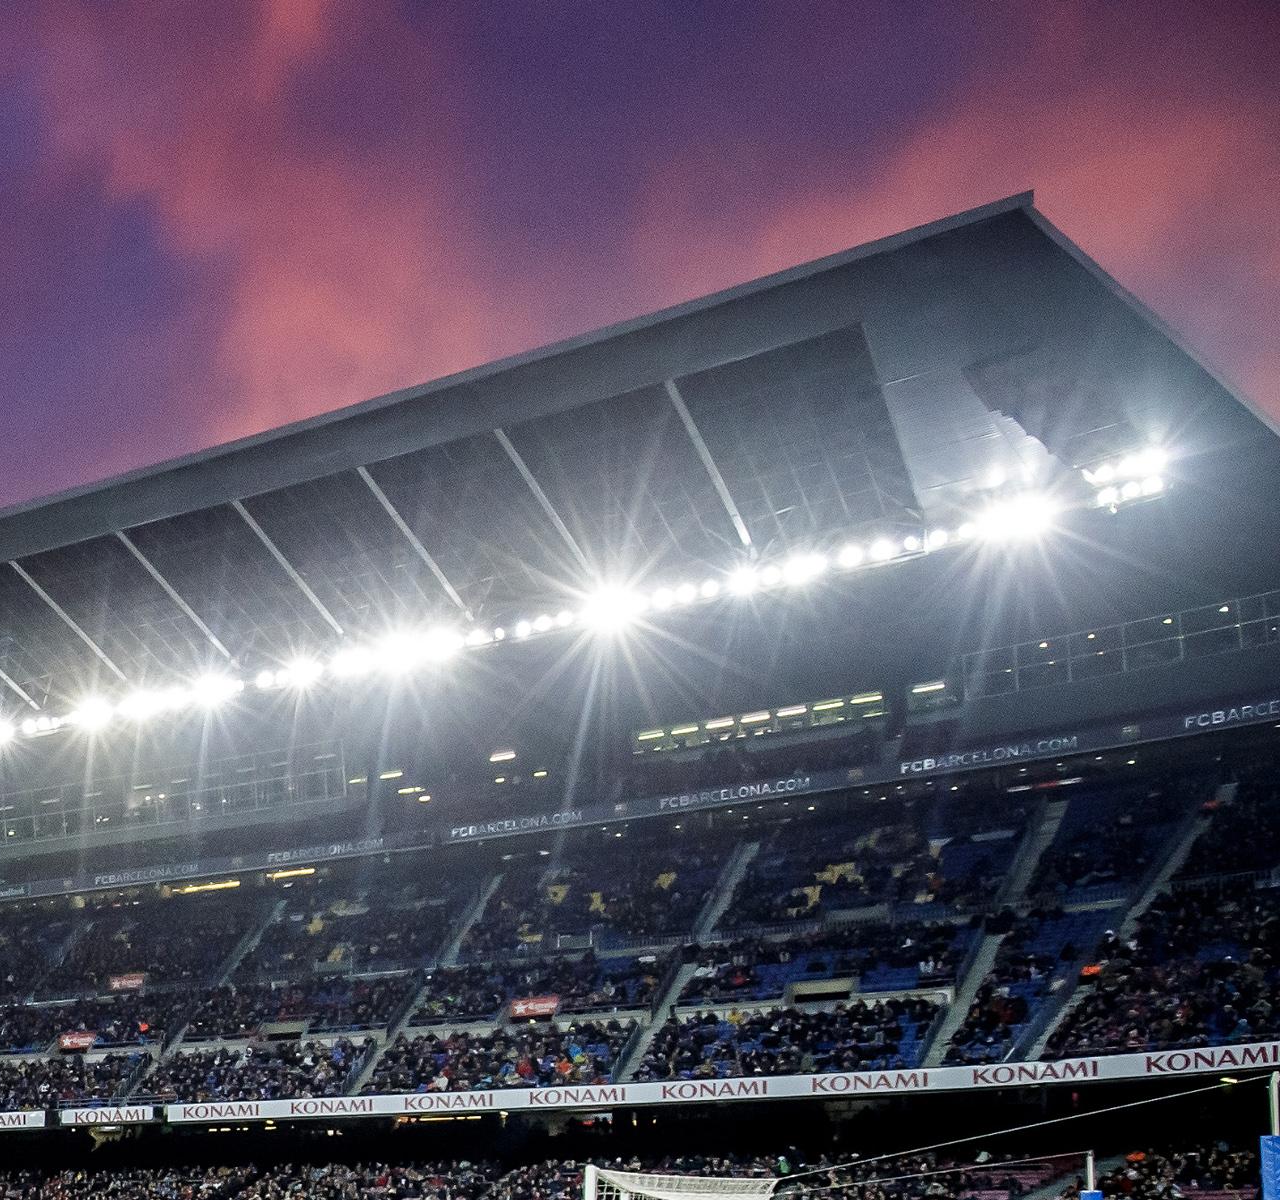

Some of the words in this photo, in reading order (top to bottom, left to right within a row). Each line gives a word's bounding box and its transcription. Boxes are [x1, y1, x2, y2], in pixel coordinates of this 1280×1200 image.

[900, 736, 1079, 774] FCBARCELONA.COM
[659, 776, 811, 811] FCBARCELONA.COM
[451, 811, 584, 838] FCBARCELONA.COM
[183, 1103, 260, 1119] KONAMI
[290, 1098, 373, 1116] KONAMI
[403, 1092, 494, 1111] KONAMI
[528, 1087, 627, 1106] KONAMI
[661, 1079, 768, 1099] KONAMI
[811, 1071, 929, 1093] KONAMI
[972, 1060, 1099, 1085] KONAMI
[1145, 1045, 1280, 1073] KONAMI
[74, 1108, 146, 1124] KONAMI
